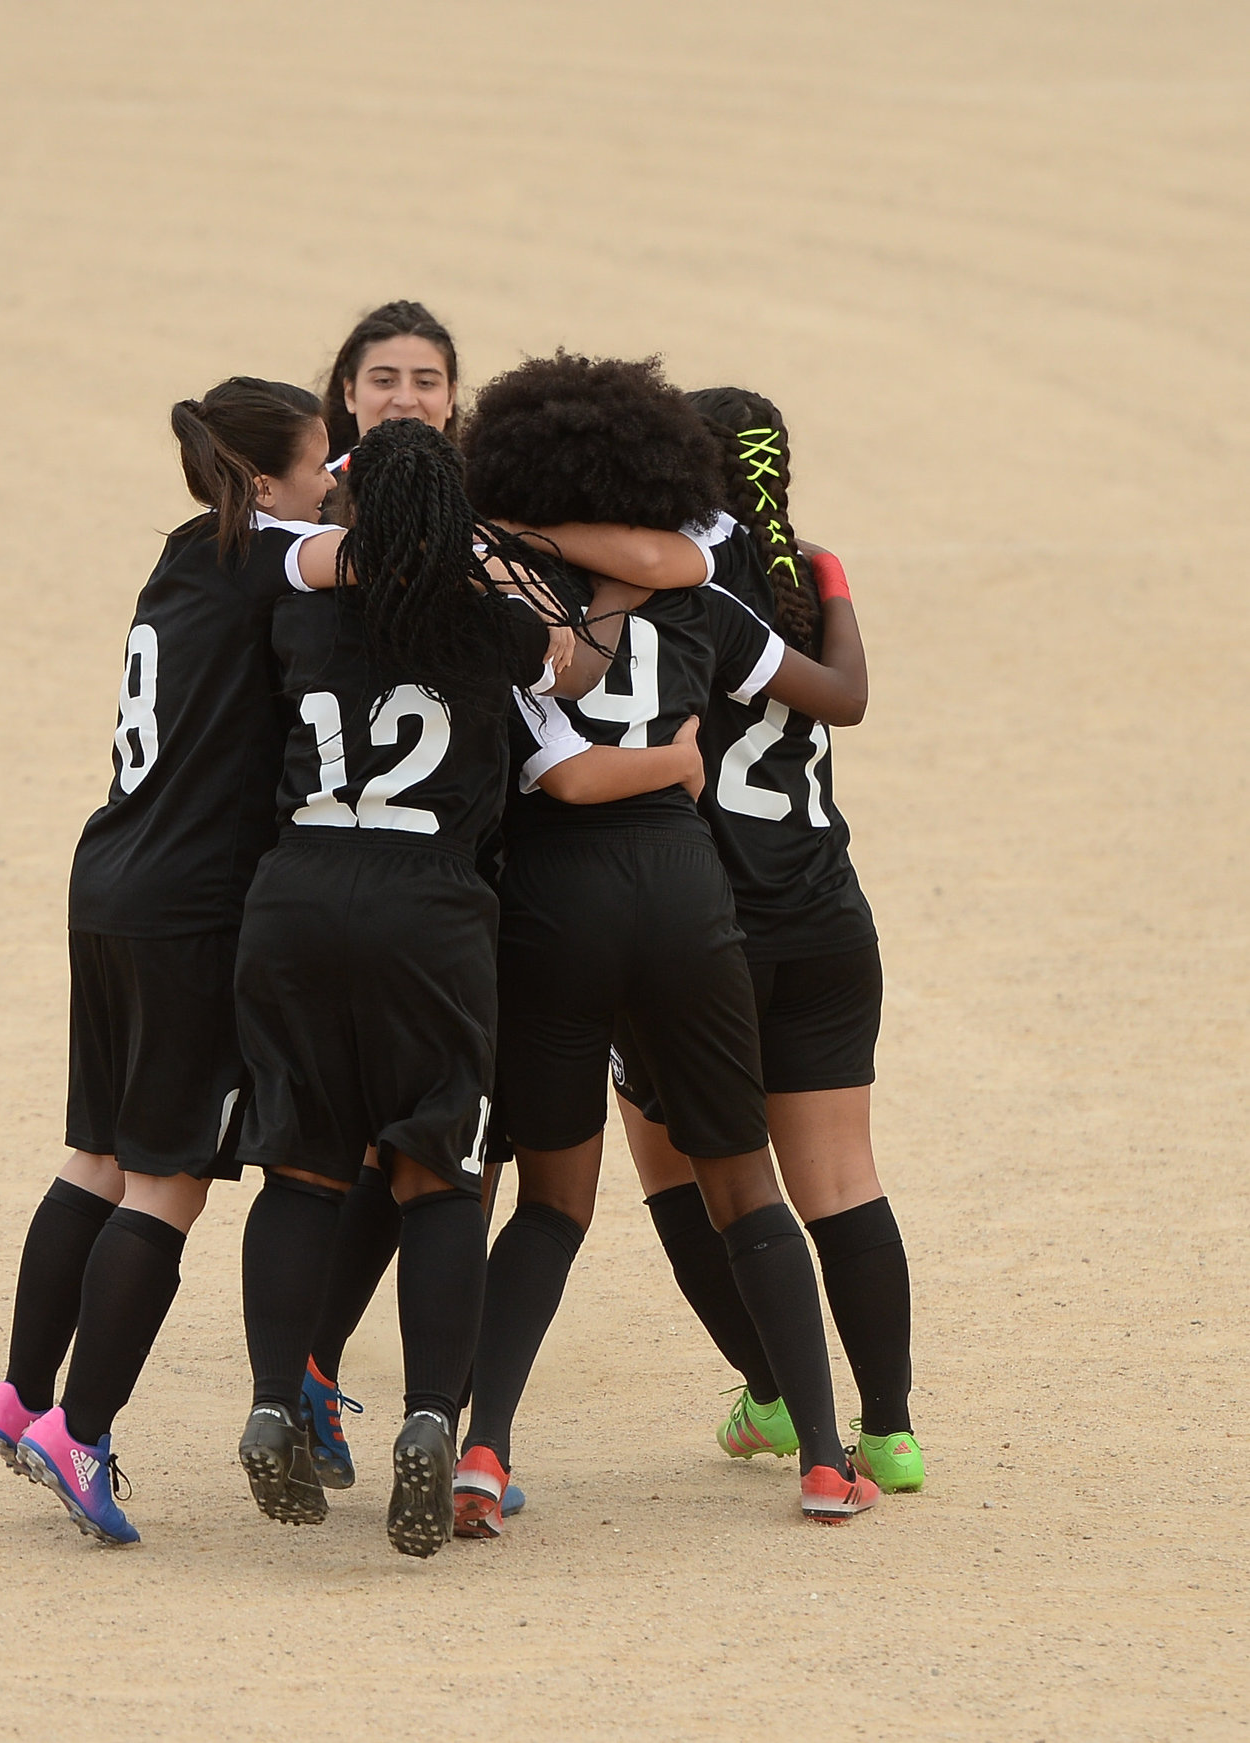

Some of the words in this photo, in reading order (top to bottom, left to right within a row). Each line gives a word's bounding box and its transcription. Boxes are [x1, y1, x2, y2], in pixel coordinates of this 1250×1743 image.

[115, 624, 159, 795] 8
[291, 684, 451, 835] 12
[461, 1095, 492, 1178] 1
[70, 1449, 90, 1492] adidas
